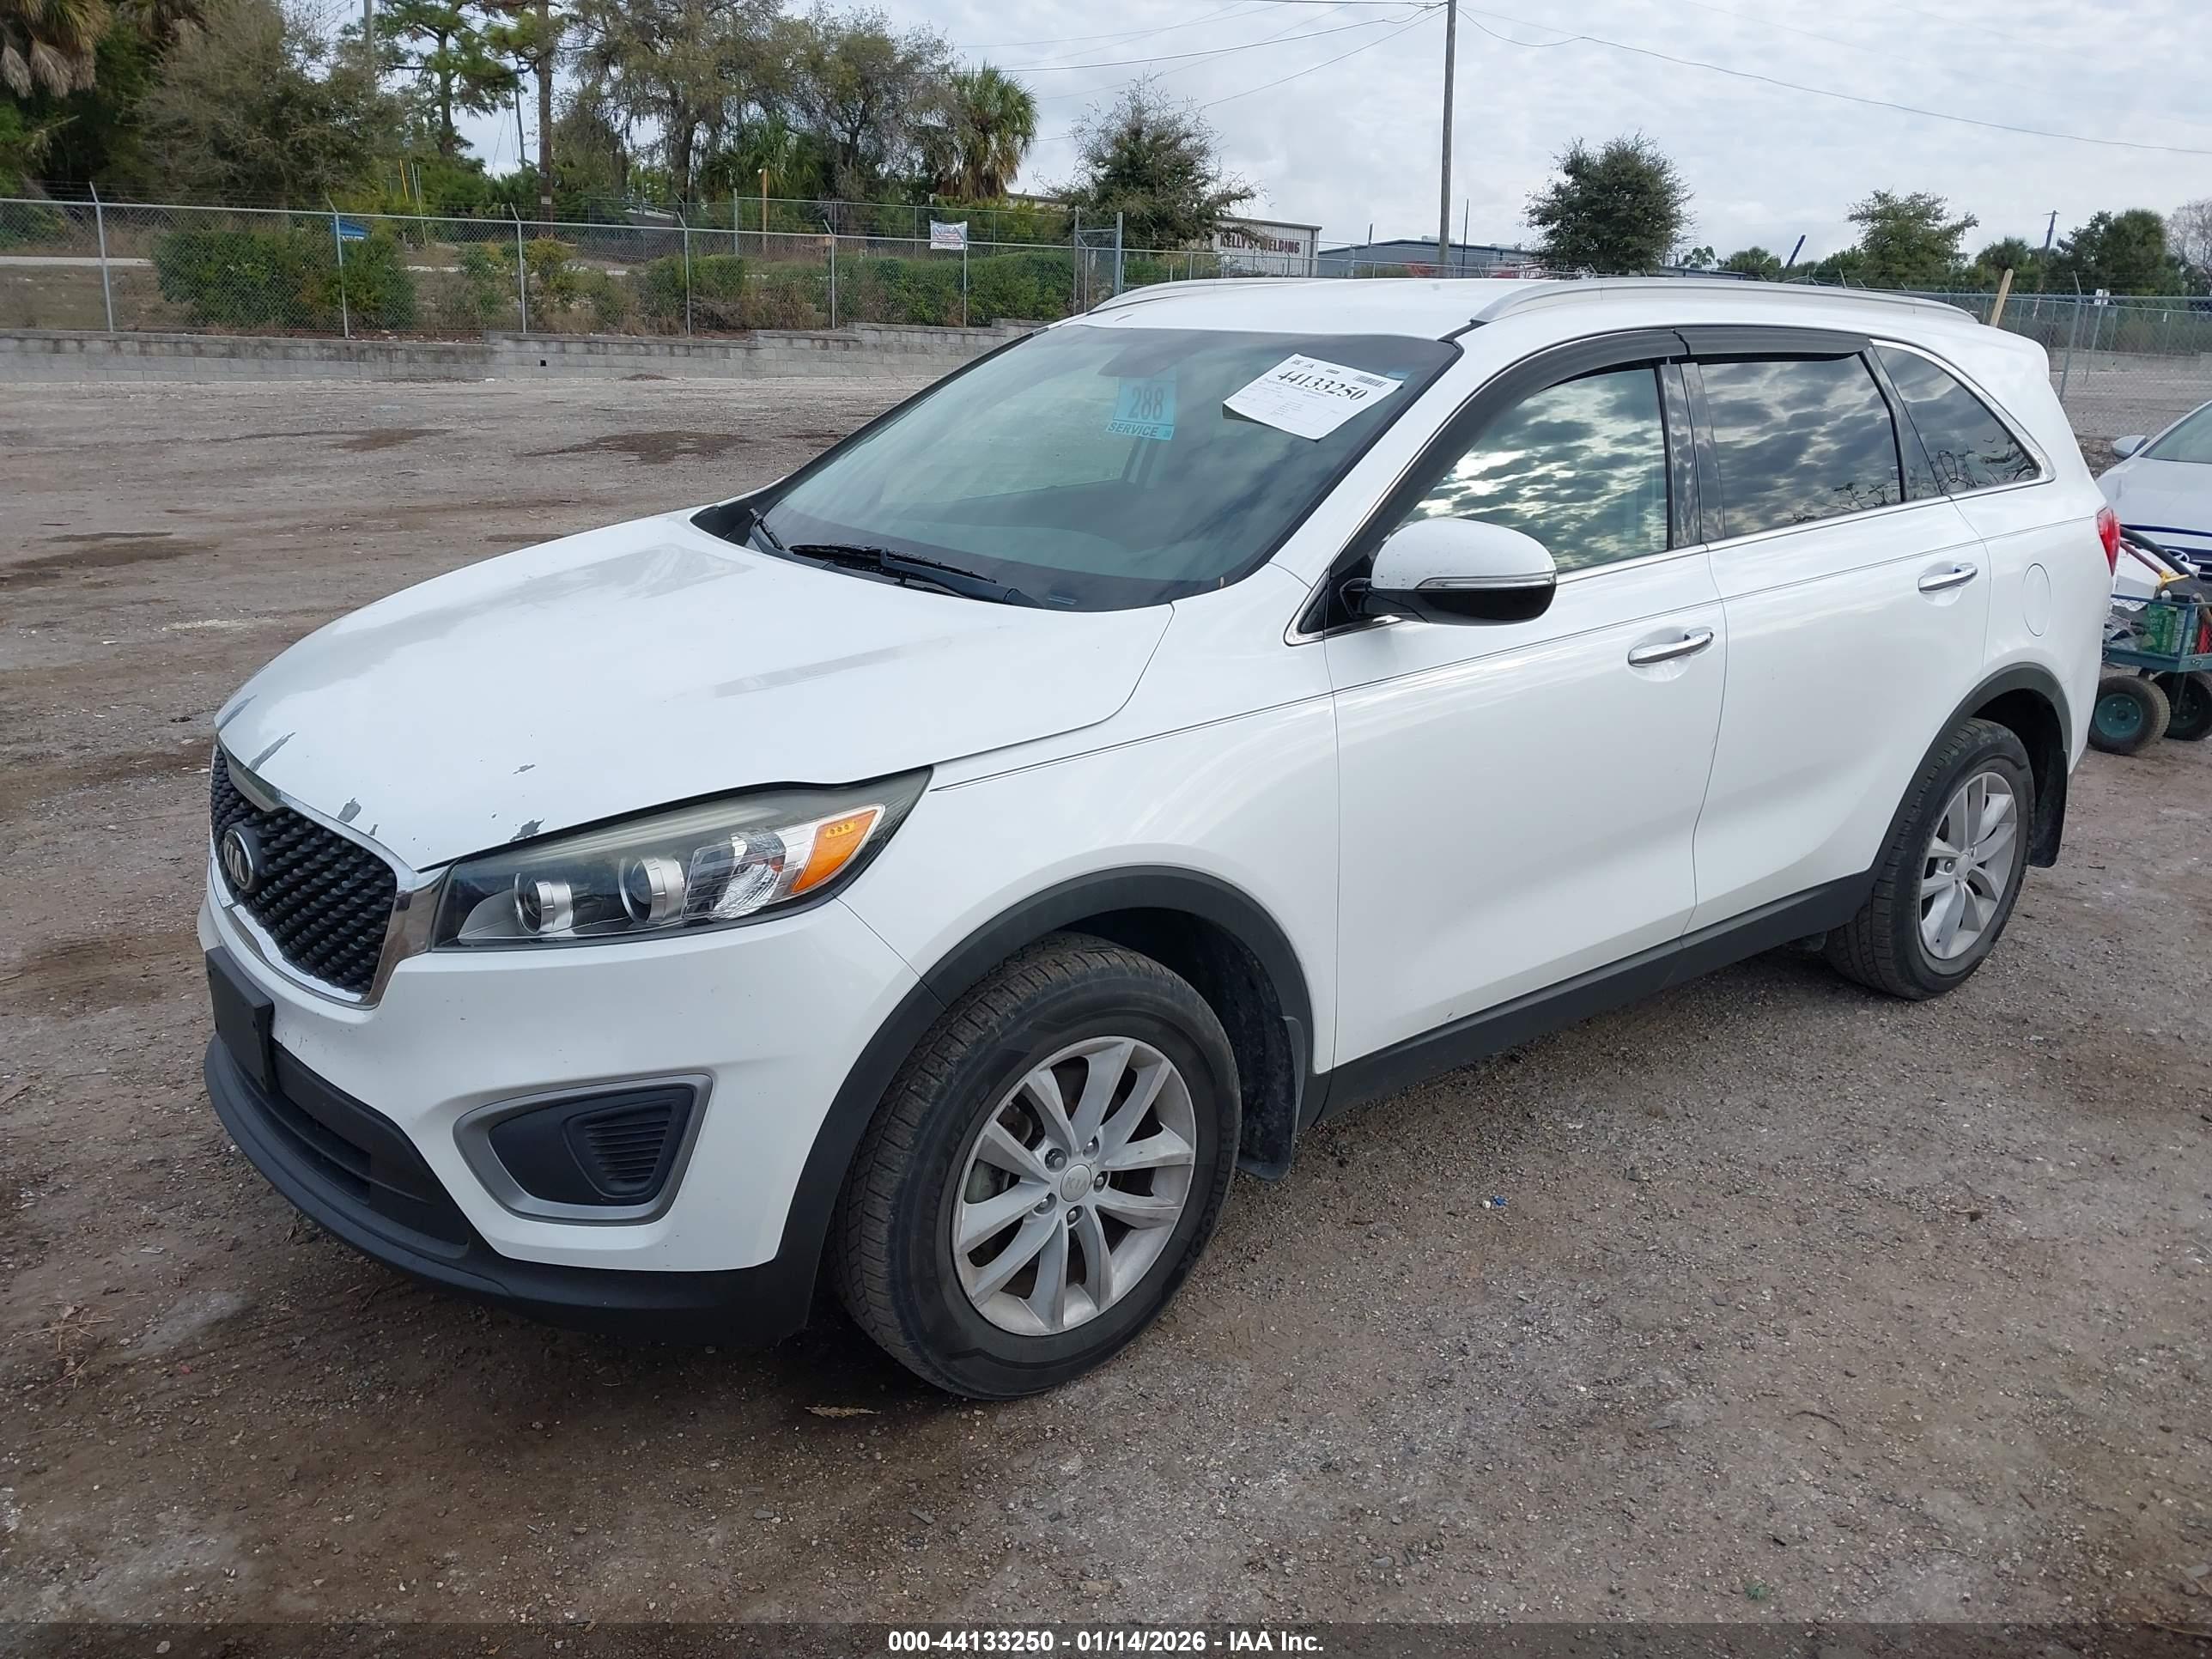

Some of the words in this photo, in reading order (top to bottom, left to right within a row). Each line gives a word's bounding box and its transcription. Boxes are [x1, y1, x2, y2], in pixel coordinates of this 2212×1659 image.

[1219, 232, 1254, 250] KELLYS
[1277, 370, 1368, 401] 44133250
[1127, 386, 1164, 421] 288
[1108, 422, 1159, 437] SERVICE
[1065, 1176, 1088, 1190] KIA
